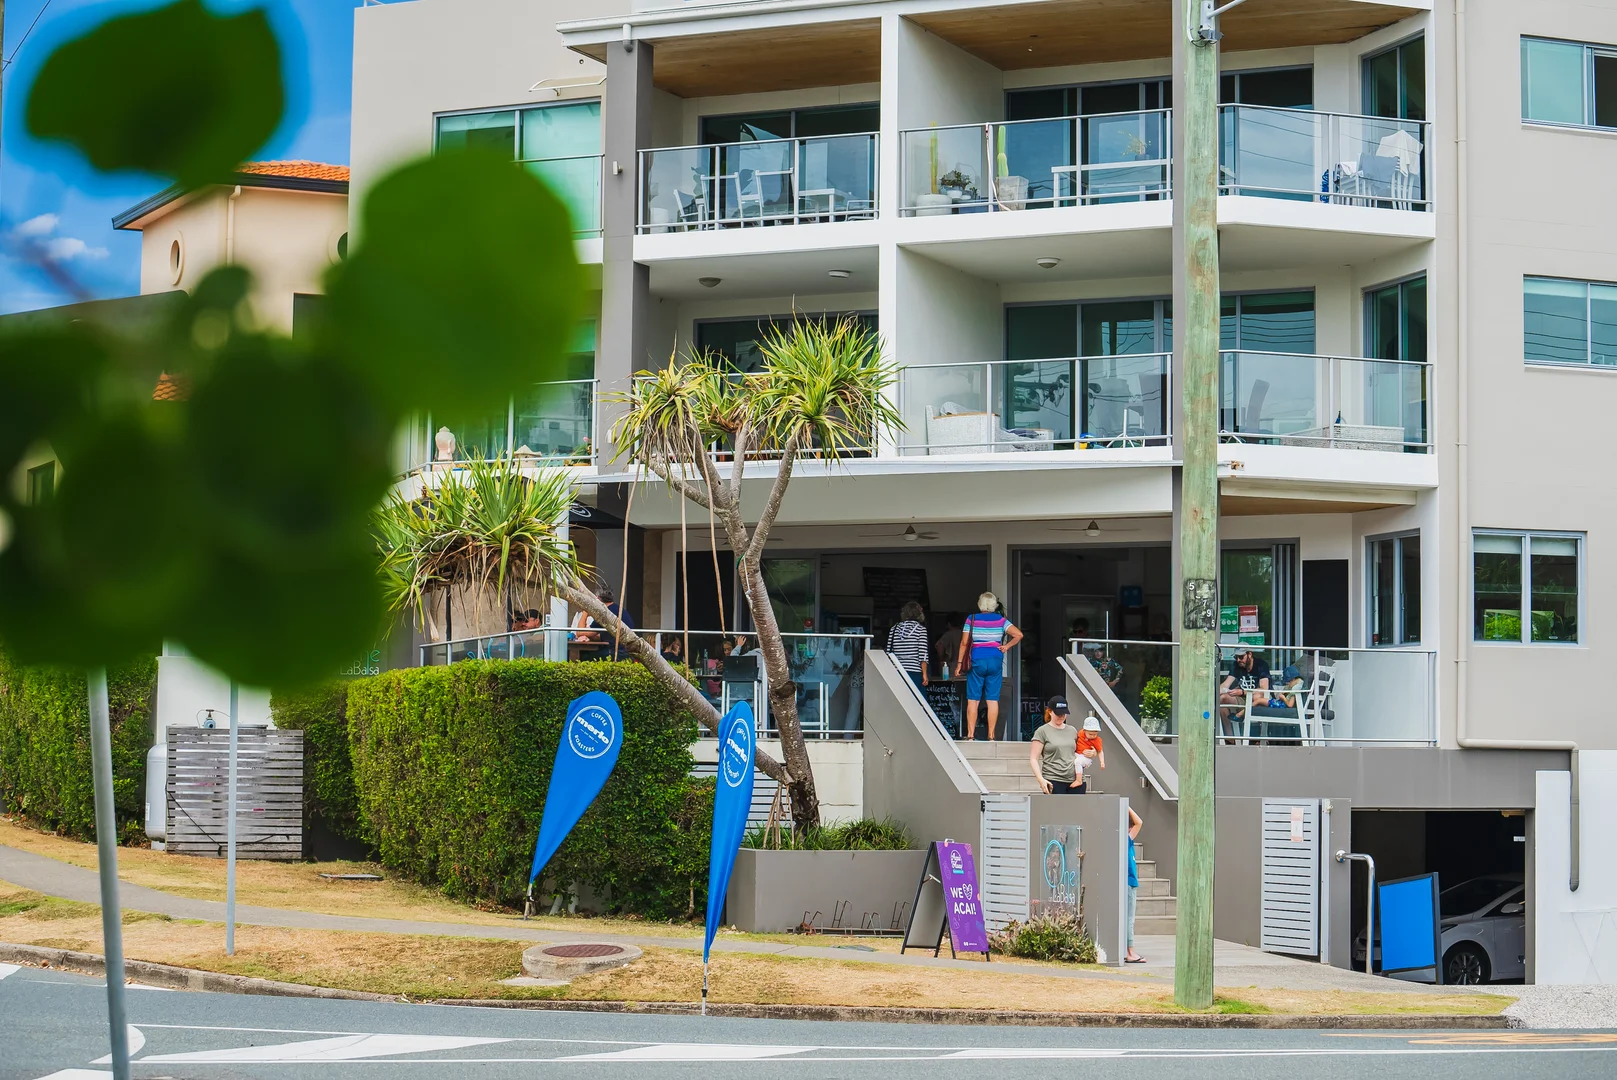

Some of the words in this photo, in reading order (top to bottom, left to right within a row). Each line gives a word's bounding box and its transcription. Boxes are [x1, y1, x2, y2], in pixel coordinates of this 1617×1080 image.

[576, 716, 610, 744] merlo
[950, 886, 964, 899] WE
[954, 902, 976, 915] ACAI!
